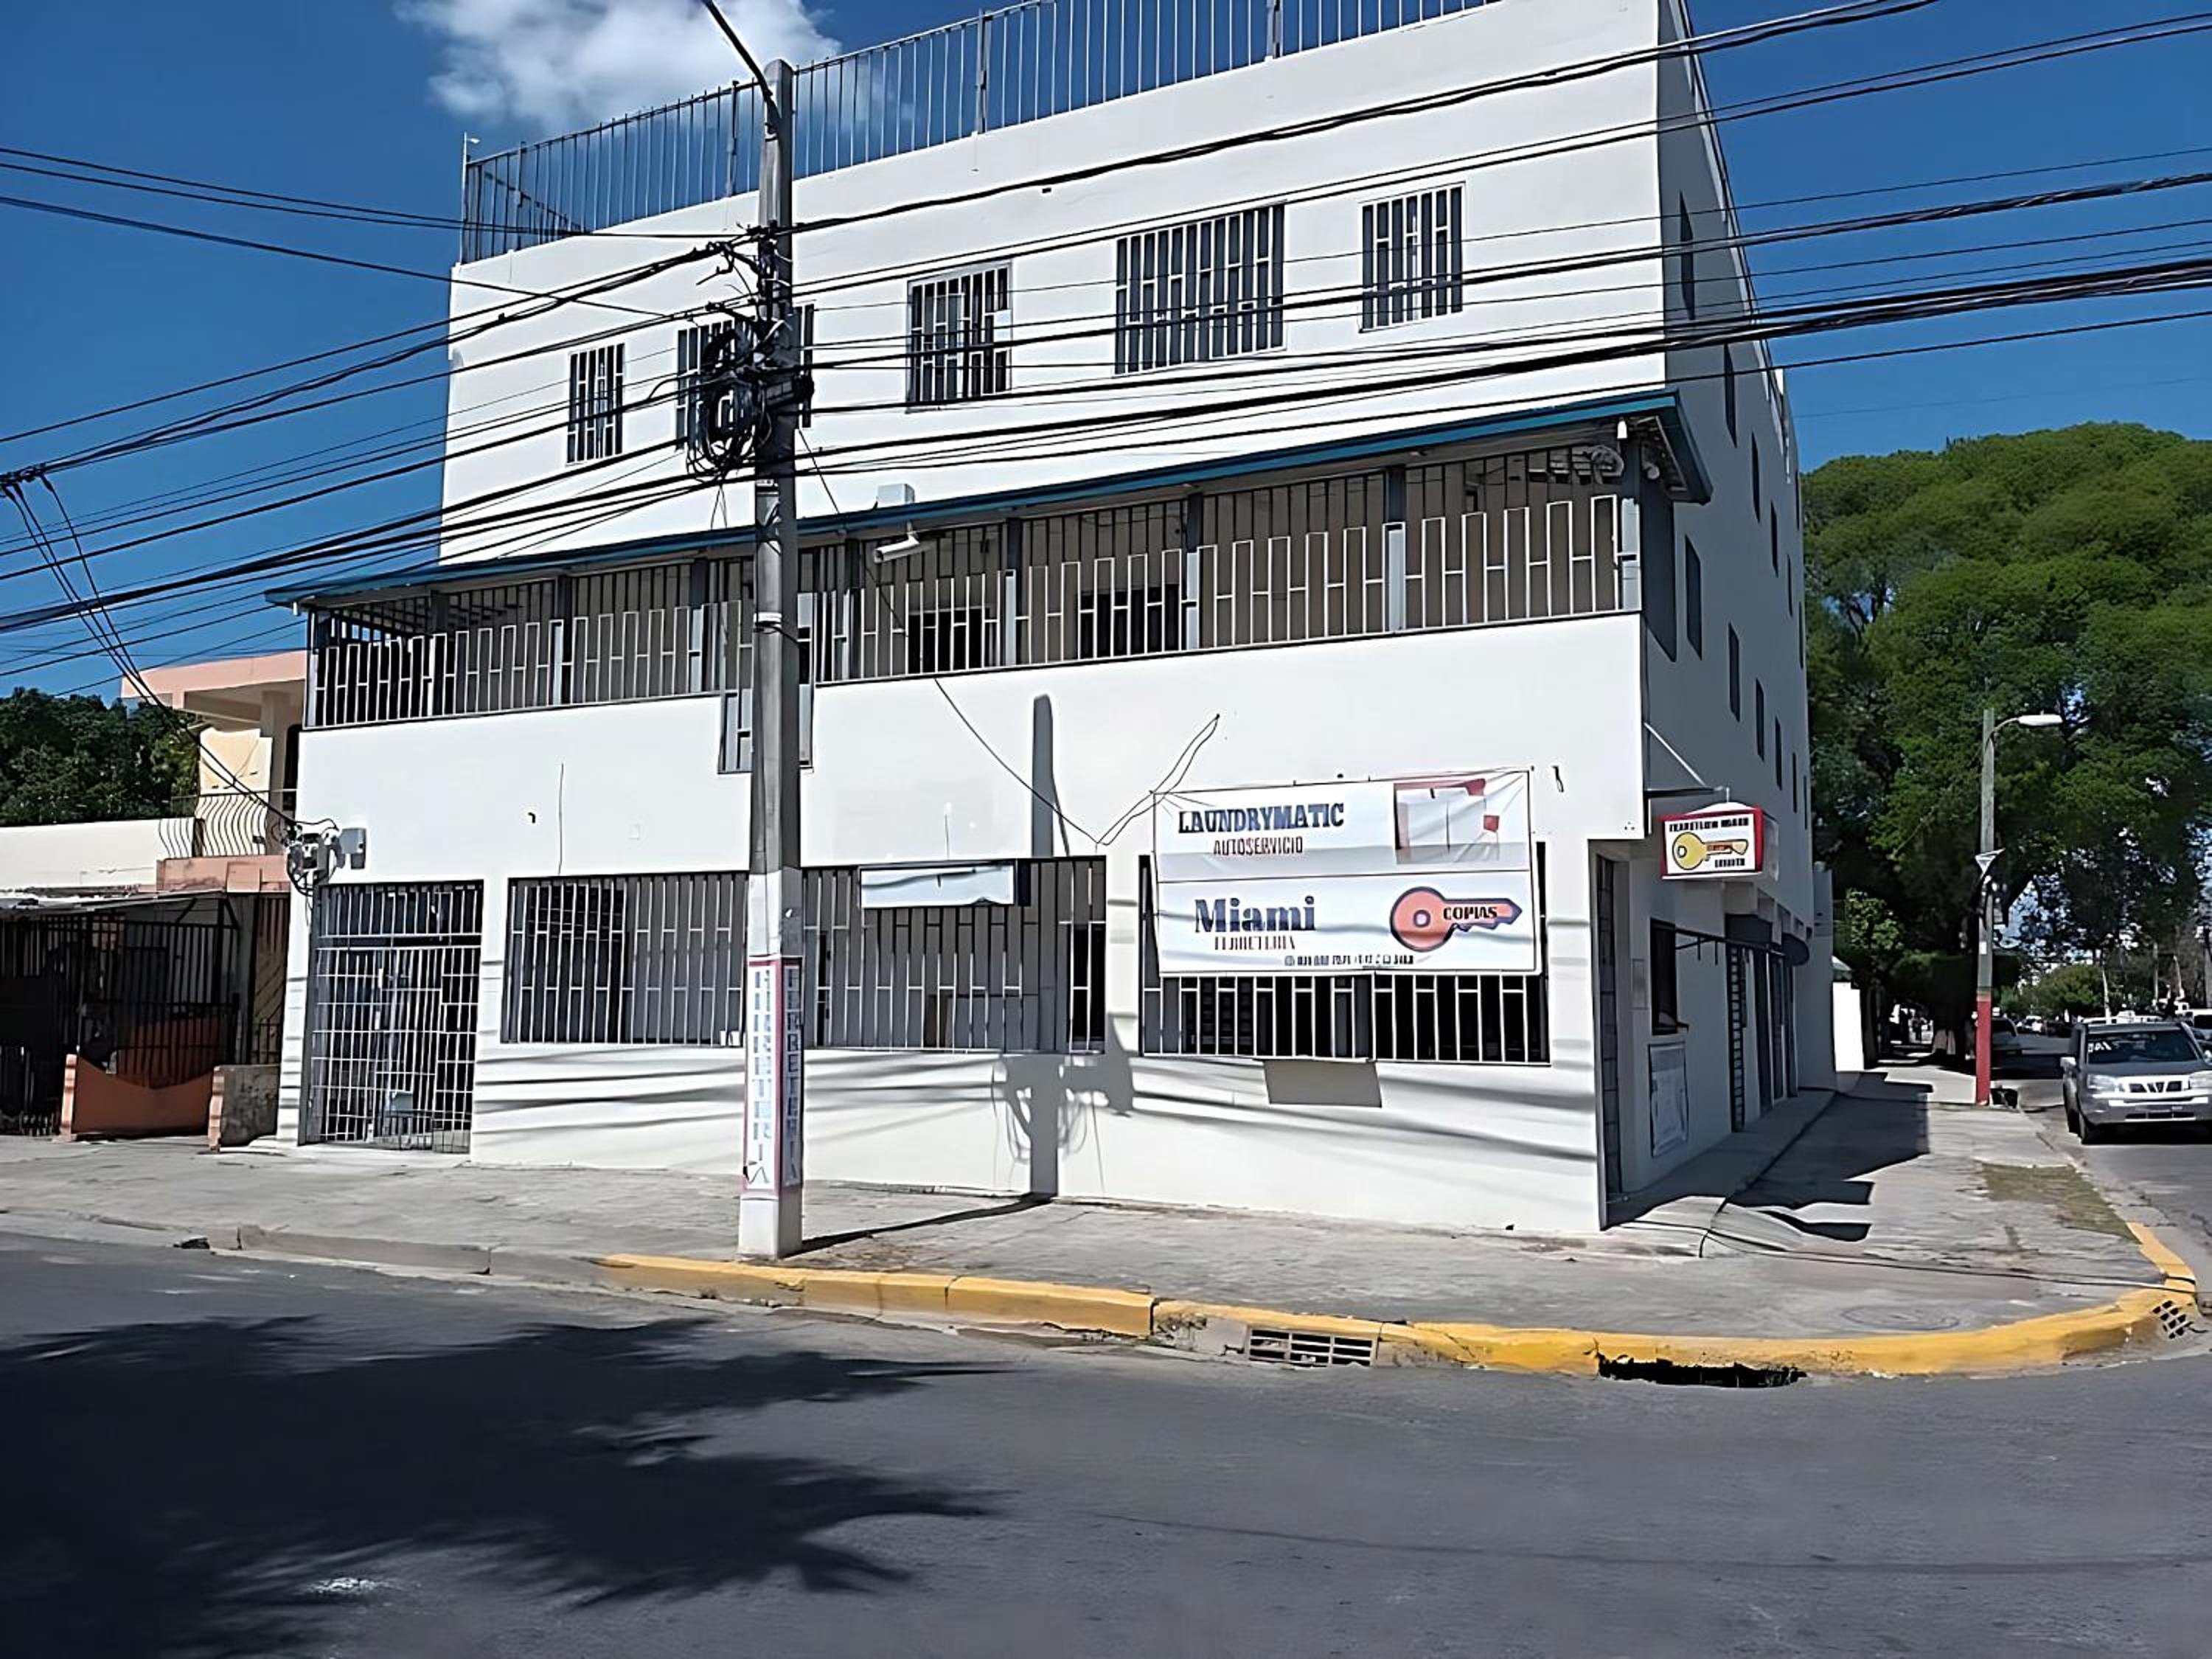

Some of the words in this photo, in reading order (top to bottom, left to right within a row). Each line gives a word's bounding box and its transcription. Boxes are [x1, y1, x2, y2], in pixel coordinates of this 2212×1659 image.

[1178, 802, 1344, 834] LAUNDRYMATIC
[1213, 835, 1304, 856] AUTOSERVICIO
[1194, 895, 1315, 933] Miami
[1443, 905, 1498, 921] COPIAS
